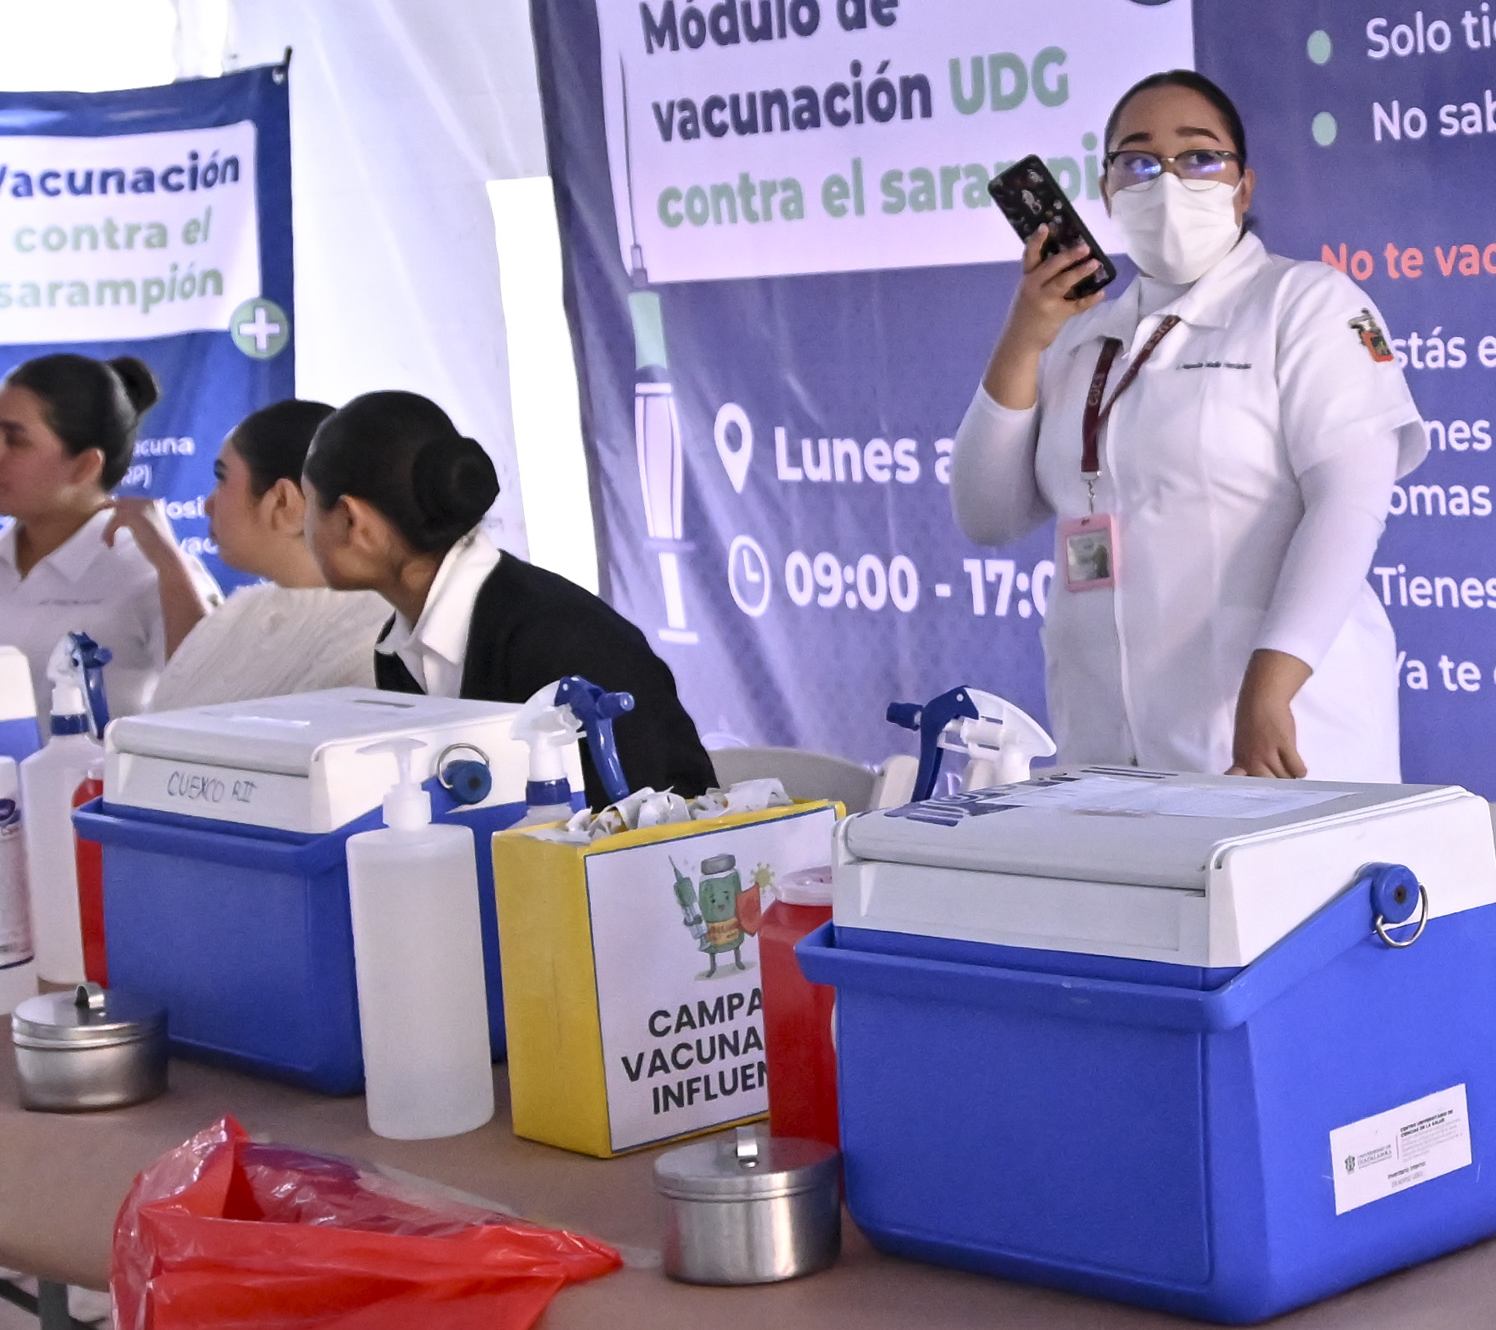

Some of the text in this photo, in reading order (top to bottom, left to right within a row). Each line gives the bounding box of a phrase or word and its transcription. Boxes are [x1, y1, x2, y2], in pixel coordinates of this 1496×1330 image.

[1365, 16, 1452, 60] Solo
[652, 46, 1070, 141] vacunación UDG
[1373, 101, 1428, 143] No
[658, 132, 1101, 227] contra el sarapi
[14, 207, 212, 253] contra el
[1321, 242, 1374, 282] No
[1384, 240, 1424, 279] te
[1392, 326, 1466, 370] stás
[775, 426, 920, 484] Lunes
[1426, 419, 1492, 451] nes
[1389, 483, 1492, 517] omas
[785, 550, 1055, 618] 09:00 - 17:0
[1438, 654, 1481, 692] te
[647, 986, 764, 1039] CAMPA
[620, 1026, 764, 1083] VACUNA
